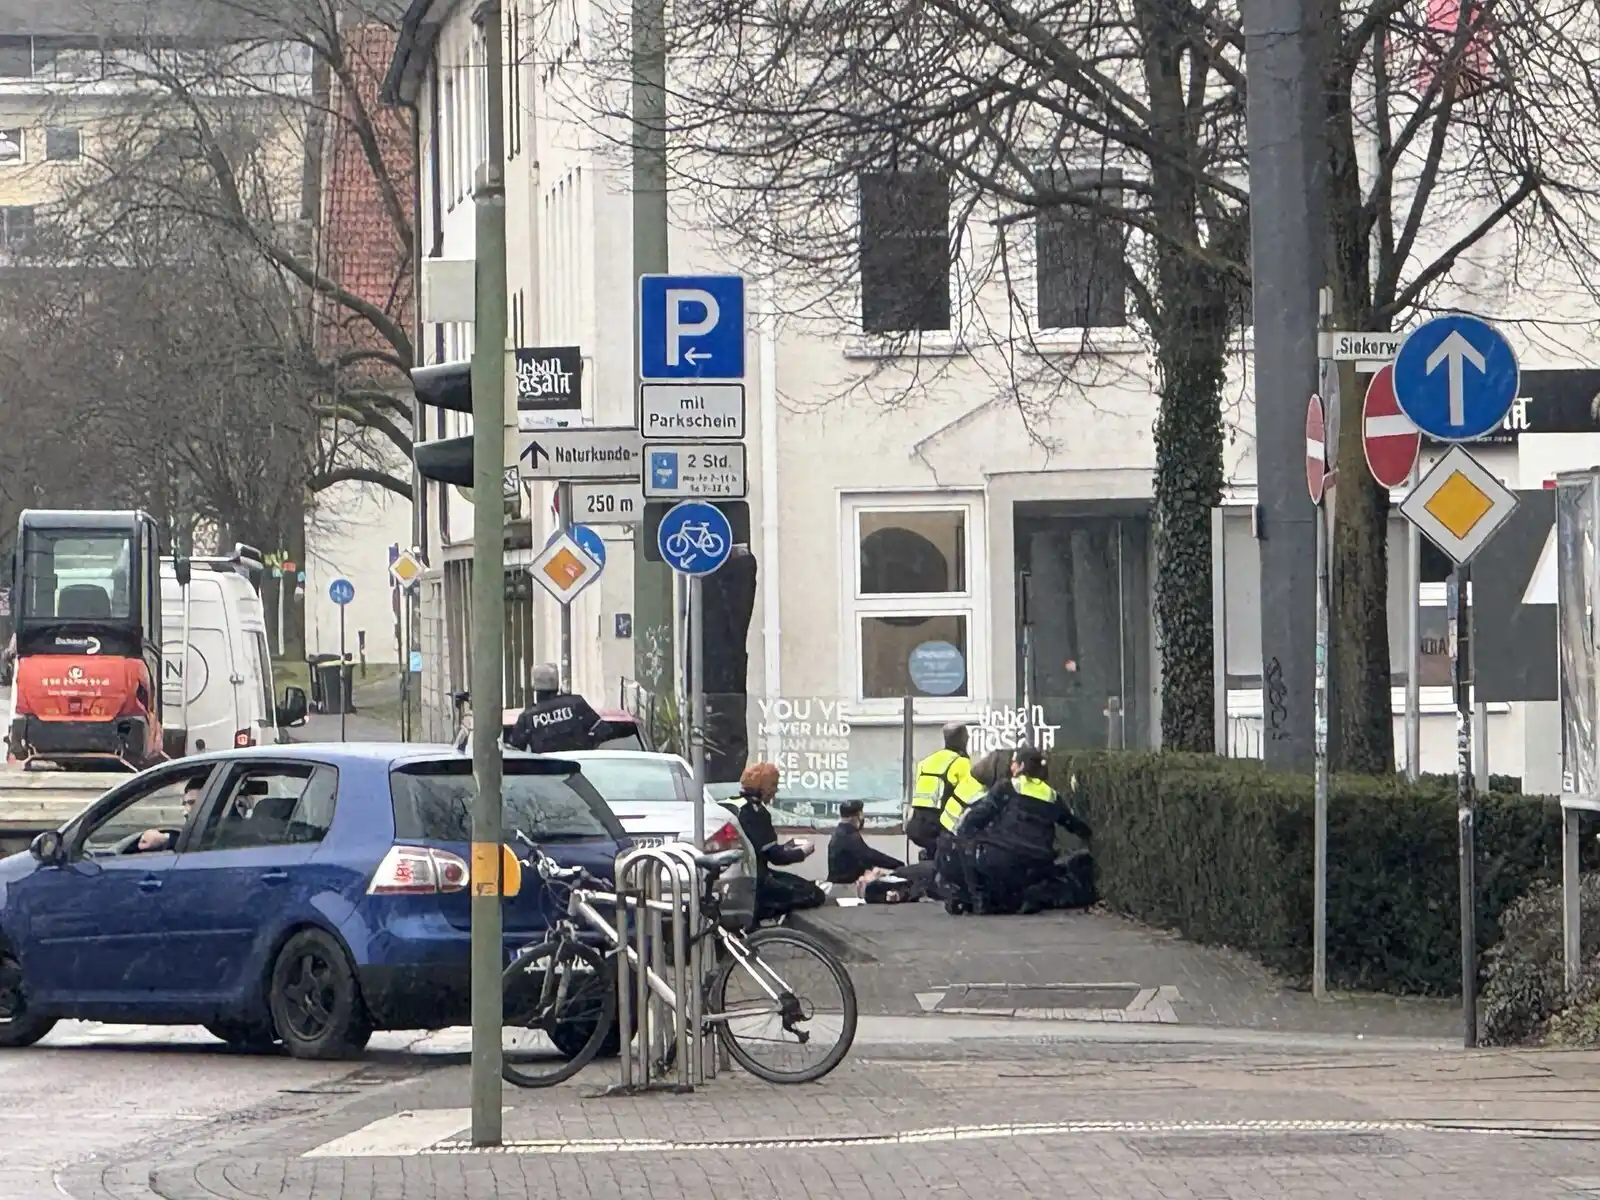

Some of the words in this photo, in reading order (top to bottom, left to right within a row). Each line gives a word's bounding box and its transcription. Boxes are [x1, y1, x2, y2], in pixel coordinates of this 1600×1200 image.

[666, 288, 720, 366] P
[1340, 337, 1400, 355] Siekerw
[649, 413, 736, 428] Parkschein
[687, 454, 697, 468] 2
[587, 495, 614, 512] 250
[620, 498, 633, 512] m
[532, 706, 573, 728] POLIZEI
[758, 721, 811, 736] NVER
[815, 721, 851, 737] HAD
[804, 752, 848, 770] THIS
[777, 770, 849, 791] EFORE
